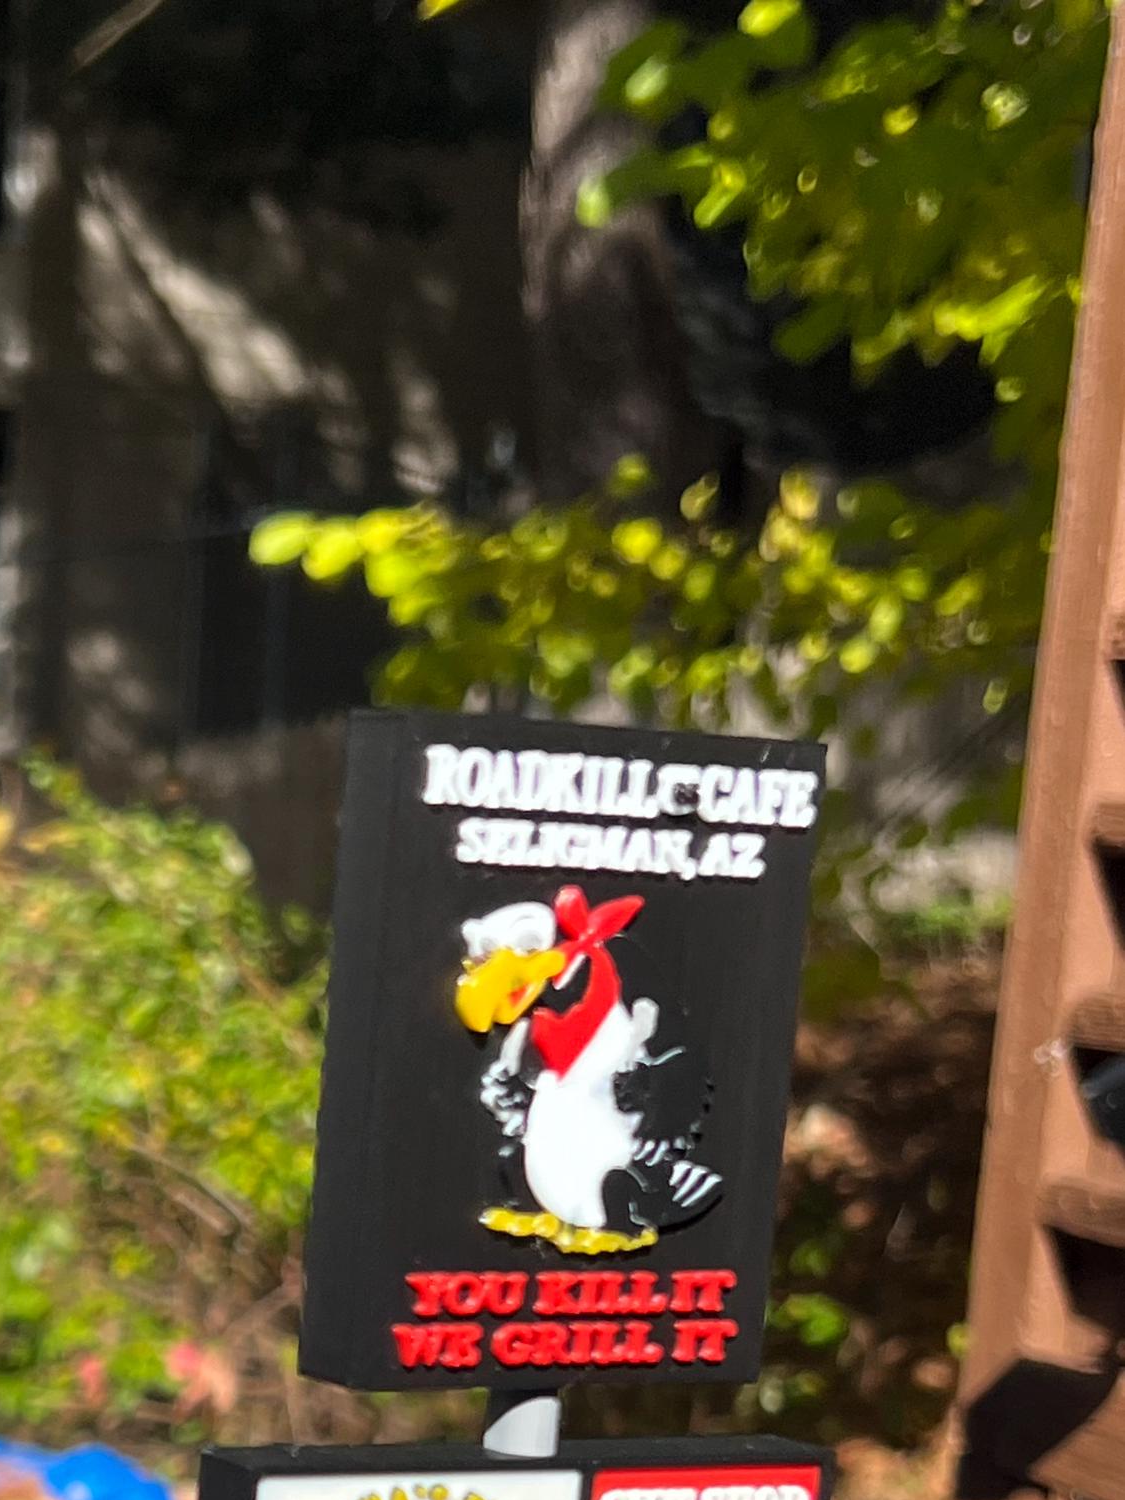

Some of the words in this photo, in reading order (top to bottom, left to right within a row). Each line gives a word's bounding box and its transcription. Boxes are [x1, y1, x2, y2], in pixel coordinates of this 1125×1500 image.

[423, 743, 659, 818] ROADKILL
[697, 764, 818, 828] CAFE
[697, 832, 766, 879] AZ
[405, 1271, 529, 1316] YOU
[532, 1269, 667, 1316] KILL
[670, 1269, 738, 1313] IT
[391, 1322, 484, 1369] WE
[491, 1320, 664, 1367] GRILL
[671, 1318, 739, 1365] IT
